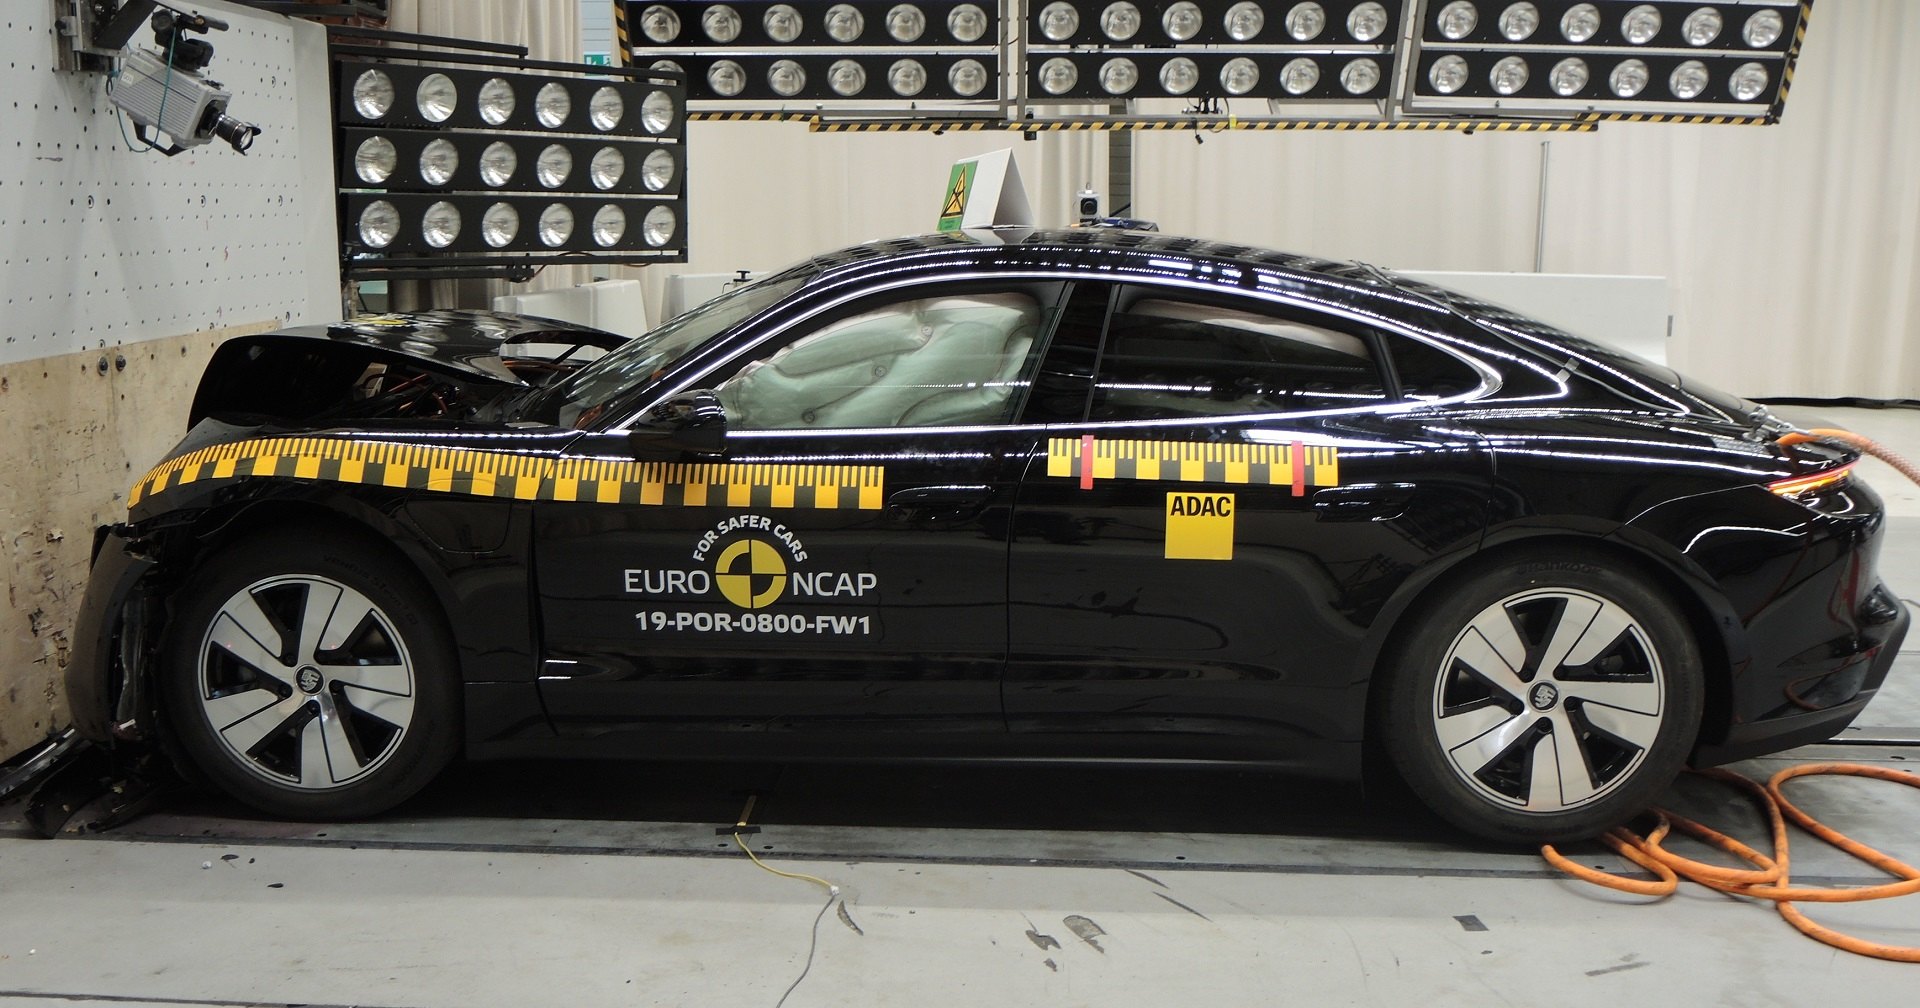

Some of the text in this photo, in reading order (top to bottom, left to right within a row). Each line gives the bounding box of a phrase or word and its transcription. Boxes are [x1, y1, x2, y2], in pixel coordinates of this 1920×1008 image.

[1170, 496, 1231, 517] ADAC
[693, 514, 808, 563] FOR SAFER CARS
[624, 568, 878, 597] EURO NCAP
[634, 610, 871, 635] 19-POR-0800-FW1
